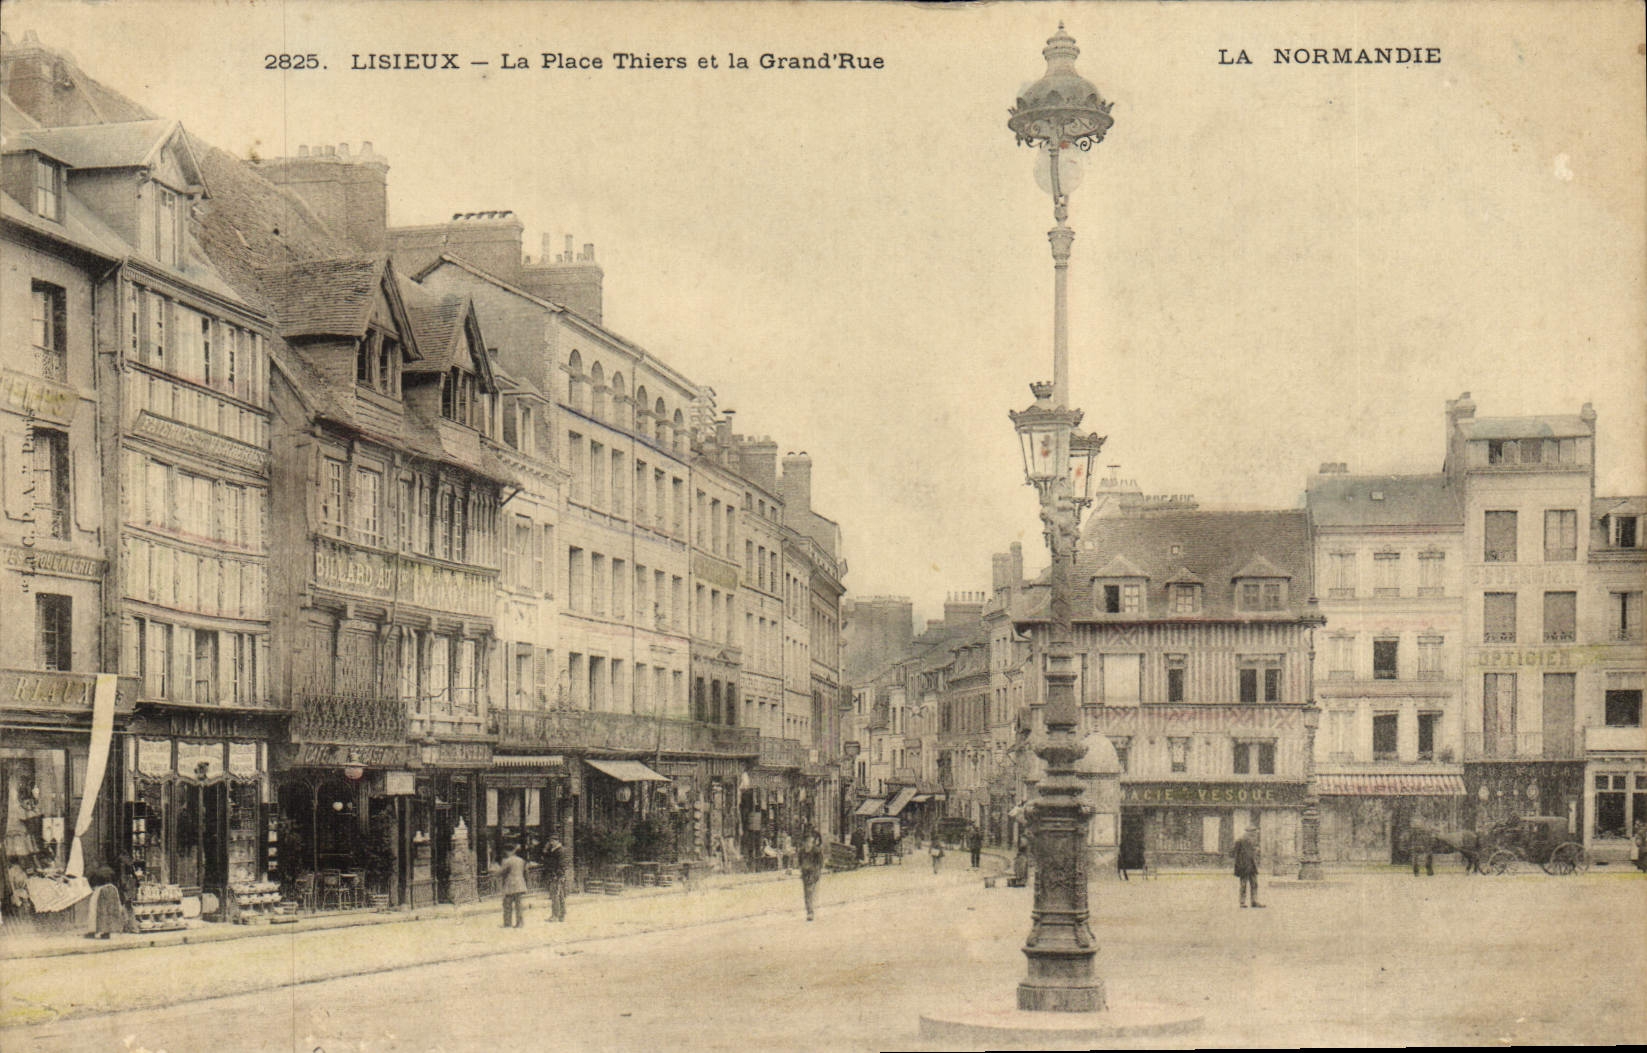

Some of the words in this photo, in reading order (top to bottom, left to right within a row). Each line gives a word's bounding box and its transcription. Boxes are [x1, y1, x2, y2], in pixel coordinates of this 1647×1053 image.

[315, 552, 374, 588] BILLARD
[377, 566, 393, 590] AU
[1478, 650, 1571, 667] OPTICIEN
